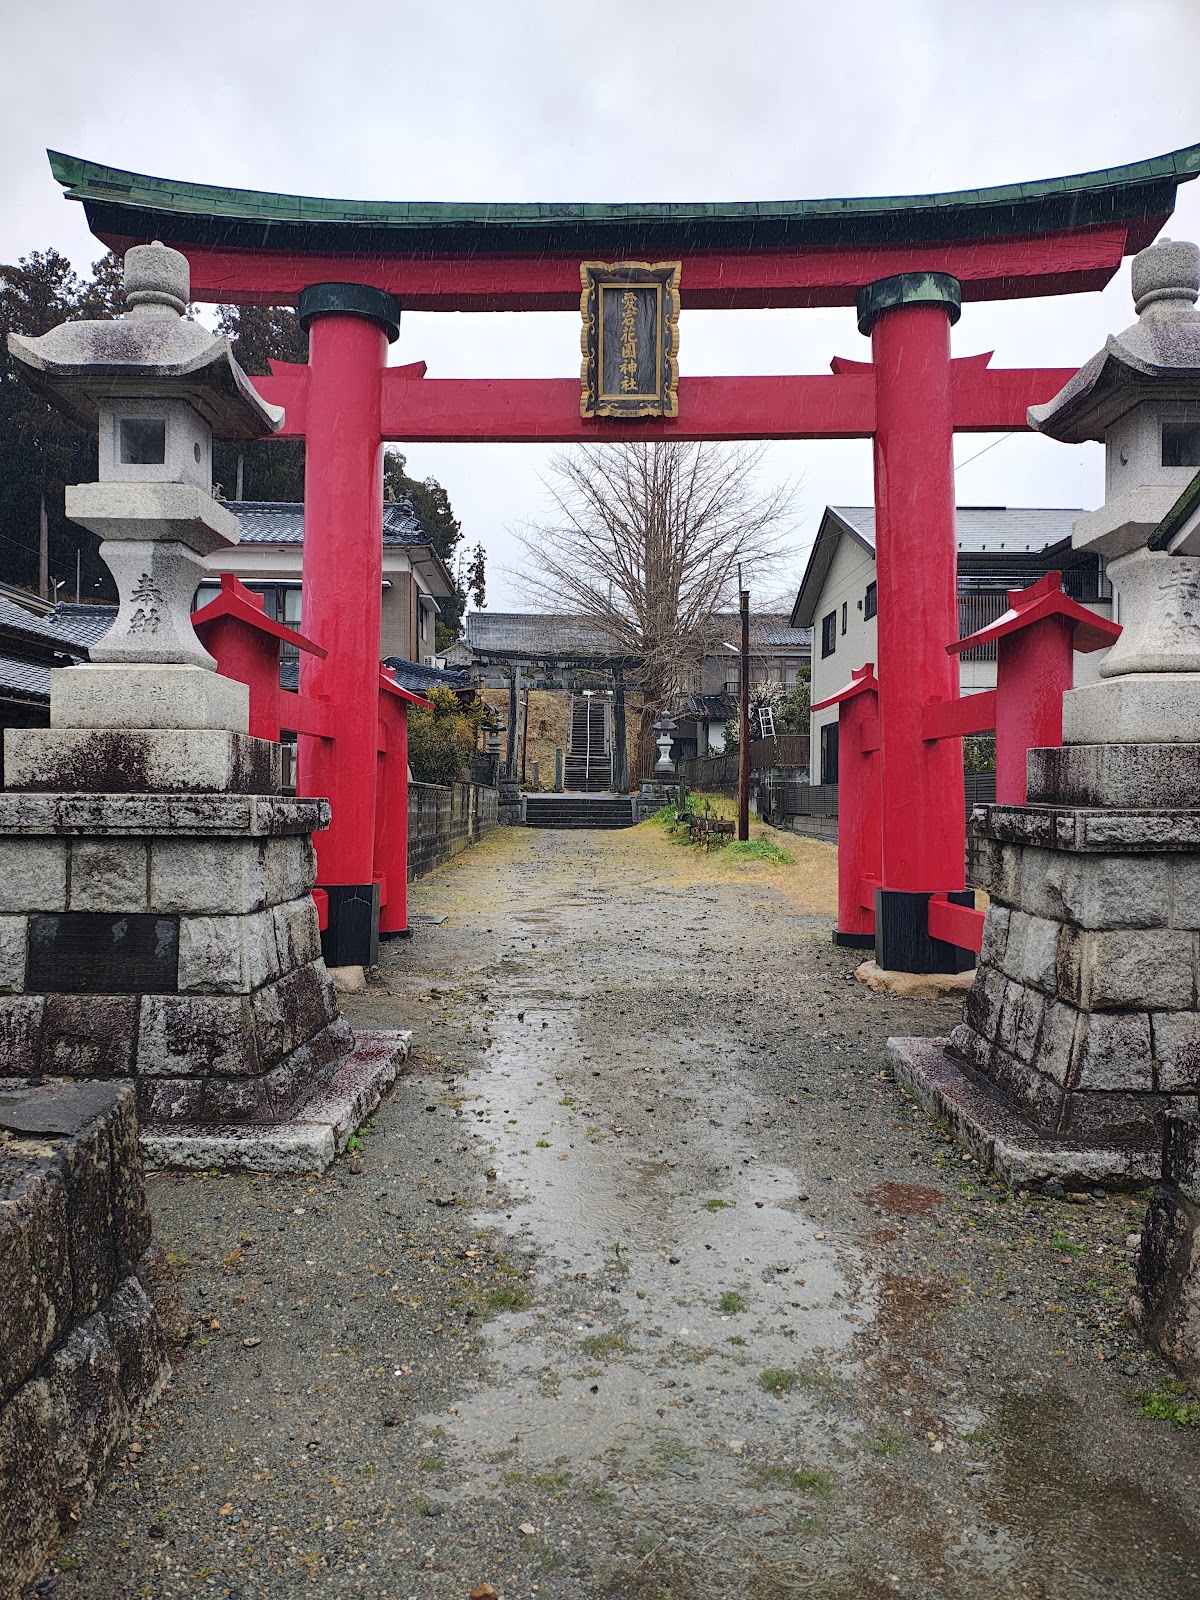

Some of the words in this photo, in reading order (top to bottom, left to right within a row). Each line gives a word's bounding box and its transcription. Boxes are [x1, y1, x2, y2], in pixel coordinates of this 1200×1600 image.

[620, 291, 639, 392] 愛宕花園神社
[127, 573, 164, 636] 奉納
